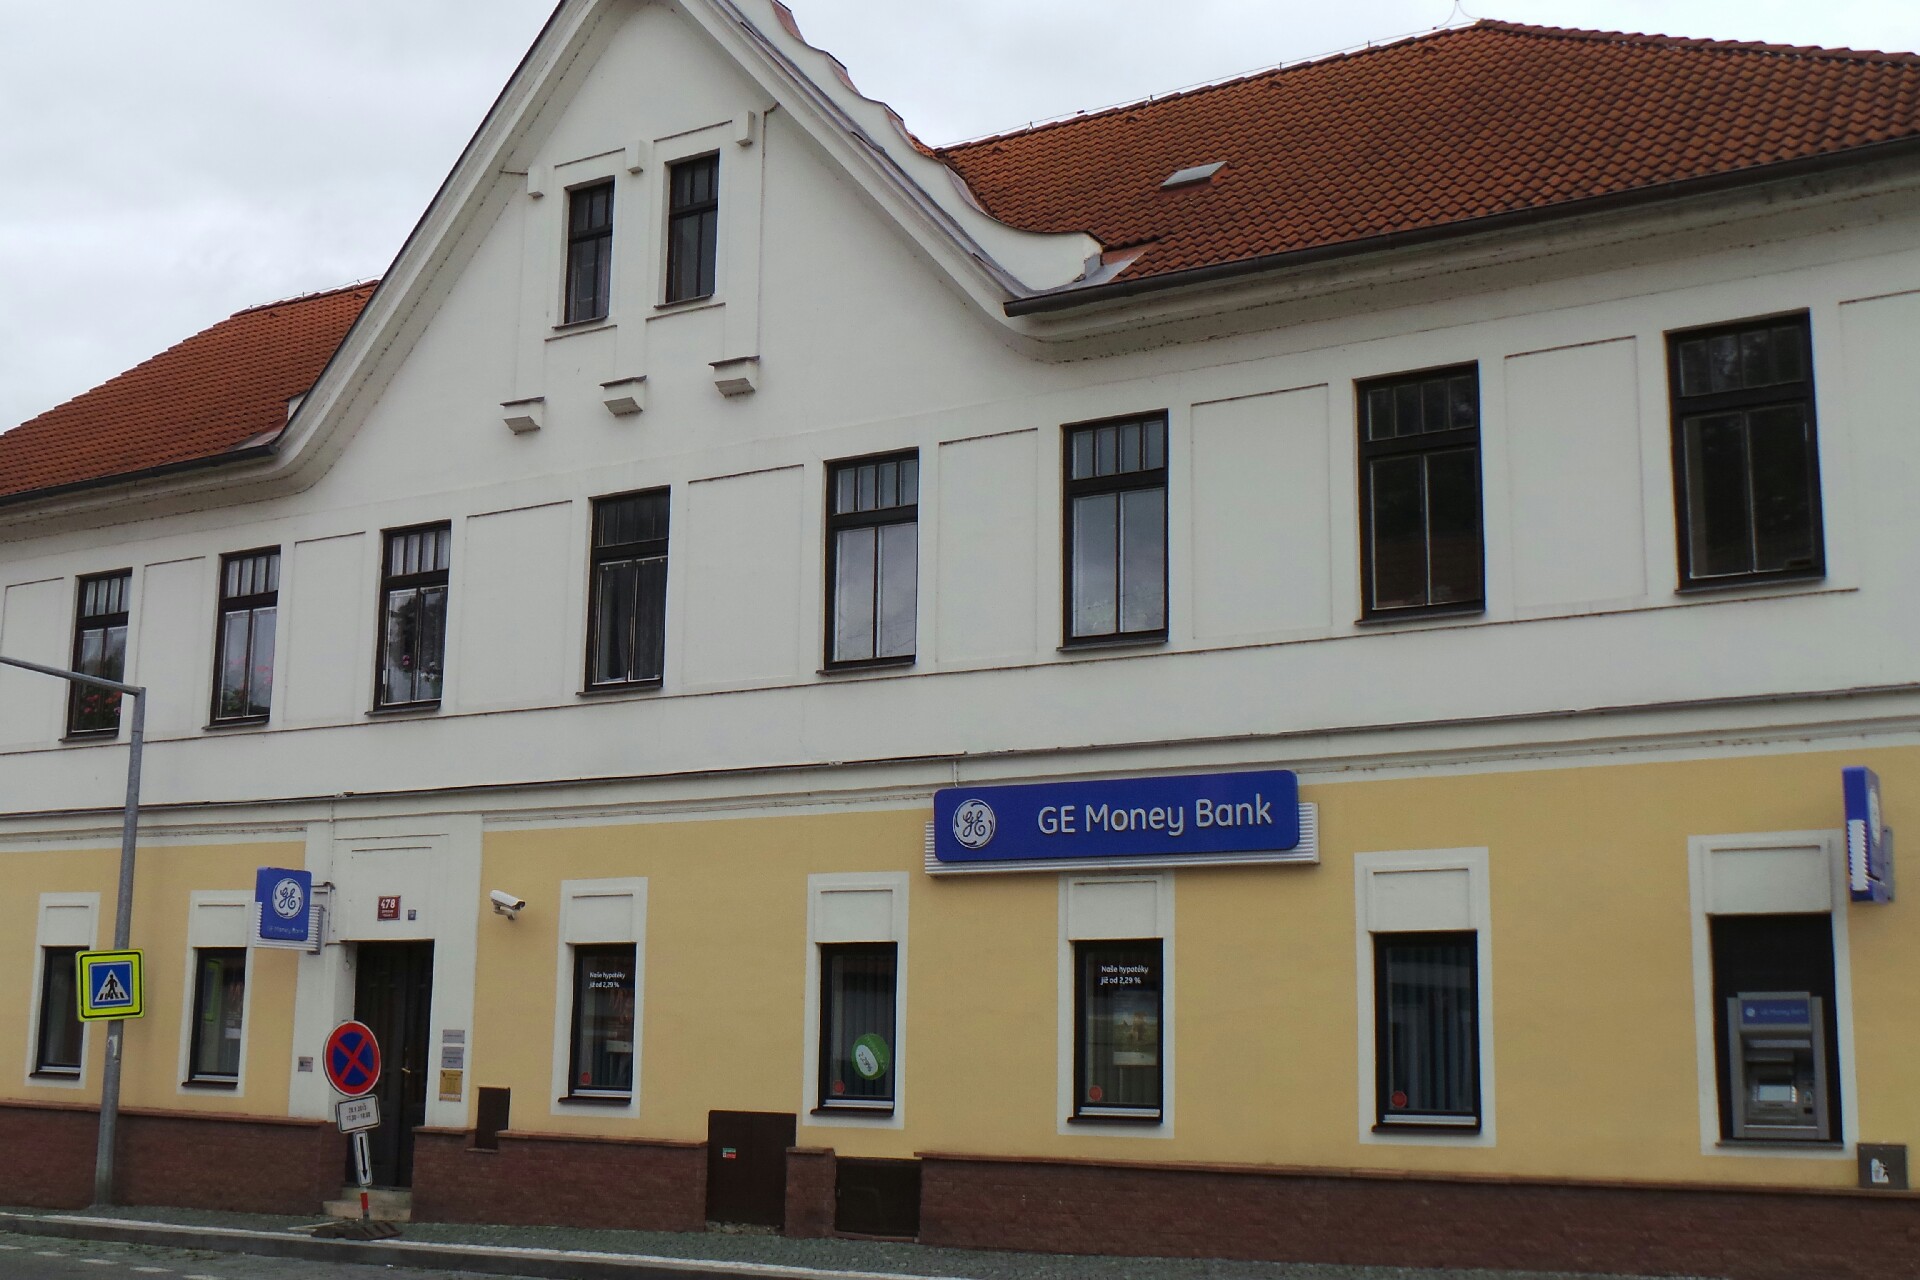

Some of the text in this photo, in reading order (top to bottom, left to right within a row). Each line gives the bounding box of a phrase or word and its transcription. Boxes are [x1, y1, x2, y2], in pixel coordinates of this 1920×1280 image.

[1037, 793, 1273, 837] GE Money Bank
[380, 898, 396, 909] 478
[1101, 964, 1149, 974] Naše hypotéky
[1109, 976, 1118, 984] od
[1119, 976, 1133, 985] 2,29
[1134, 976, 1141, 984] %
